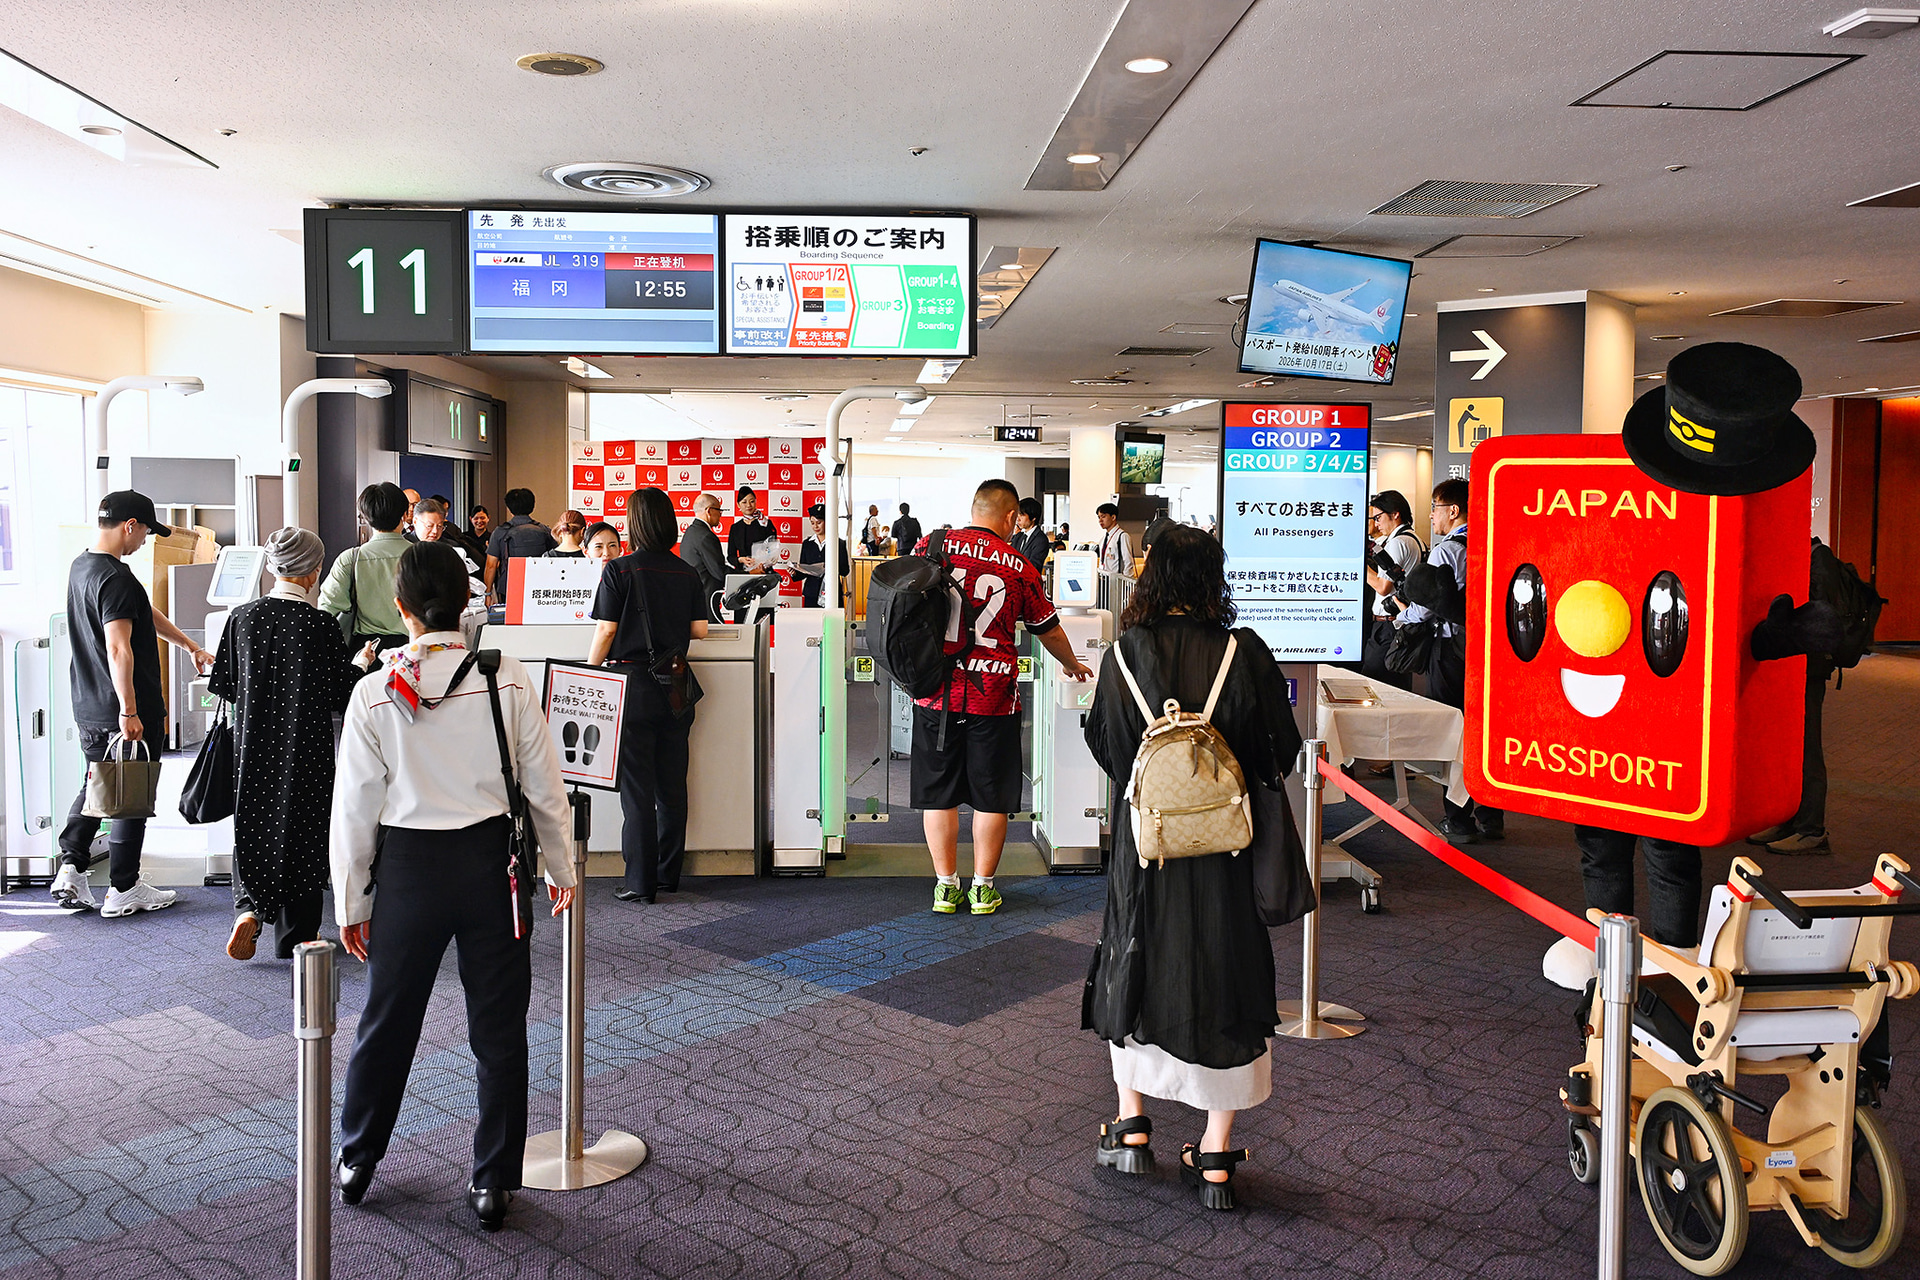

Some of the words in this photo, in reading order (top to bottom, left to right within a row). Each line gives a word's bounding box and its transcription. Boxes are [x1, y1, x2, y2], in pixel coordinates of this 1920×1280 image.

[532, 217, 567, 228] 先出发
[745, 225, 945, 250] 搭乗順のご案内
[503, 256, 526, 264] JAL
[544, 254, 561, 267] JL
[572, 254, 599, 268] 319
[633, 256, 686, 269] 正在登机
[799, 250, 839, 261] Boarding
[840, 250, 884, 261] Sequence
[347, 248, 427, 315] 11
[634, 280, 687, 298] 12:55
[862, 301, 892, 311] GROUP
[893, 300, 903, 311] 3
[917, 297, 956, 306] すべての
[918, 306, 954, 315] お客さま
[917, 322, 955, 331] Boarding
[734, 330, 786, 340] 事前改札
[795, 330, 847, 340] 優先搭乗
[1246, 338, 1372, 361] パスポート発給160周年イベント
[1278, 356, 1348, 373] 2026年10月17日(土)
[449, 401, 461, 440] 11
[1251, 408, 1323, 426] GROUP
[1331, 409, 1341, 425] 1
[1005, 428, 1036, 440] 12:44
[1251, 431, 1323, 448] GROUP
[1329, 431, 1341, 448] 2
[1227, 453, 1299, 470] GROUP
[1304, 453, 1365, 471] 3/4/5
[1235, 500, 1354, 517] すべてのお客さま
[1523, 488, 1677, 519] JAPAN
[1254, 527, 1268, 537] All
[1272, 527, 1334, 538] Passengers
[977, 538, 990, 547] GU
[1227, 570, 1359, 581] 保安検査場でかざしたICまたは
[532, 589, 592, 599] 搭乗開始時刻
[945, 567, 1006, 649] 12
[568, 685, 605, 699] こちらで
[552, 694, 617, 712] お待ちください
[553, 706, 577, 716] PLEASE
[597, 714, 614, 722] HERE
[1505, 737, 1683, 791] PASSPORT
